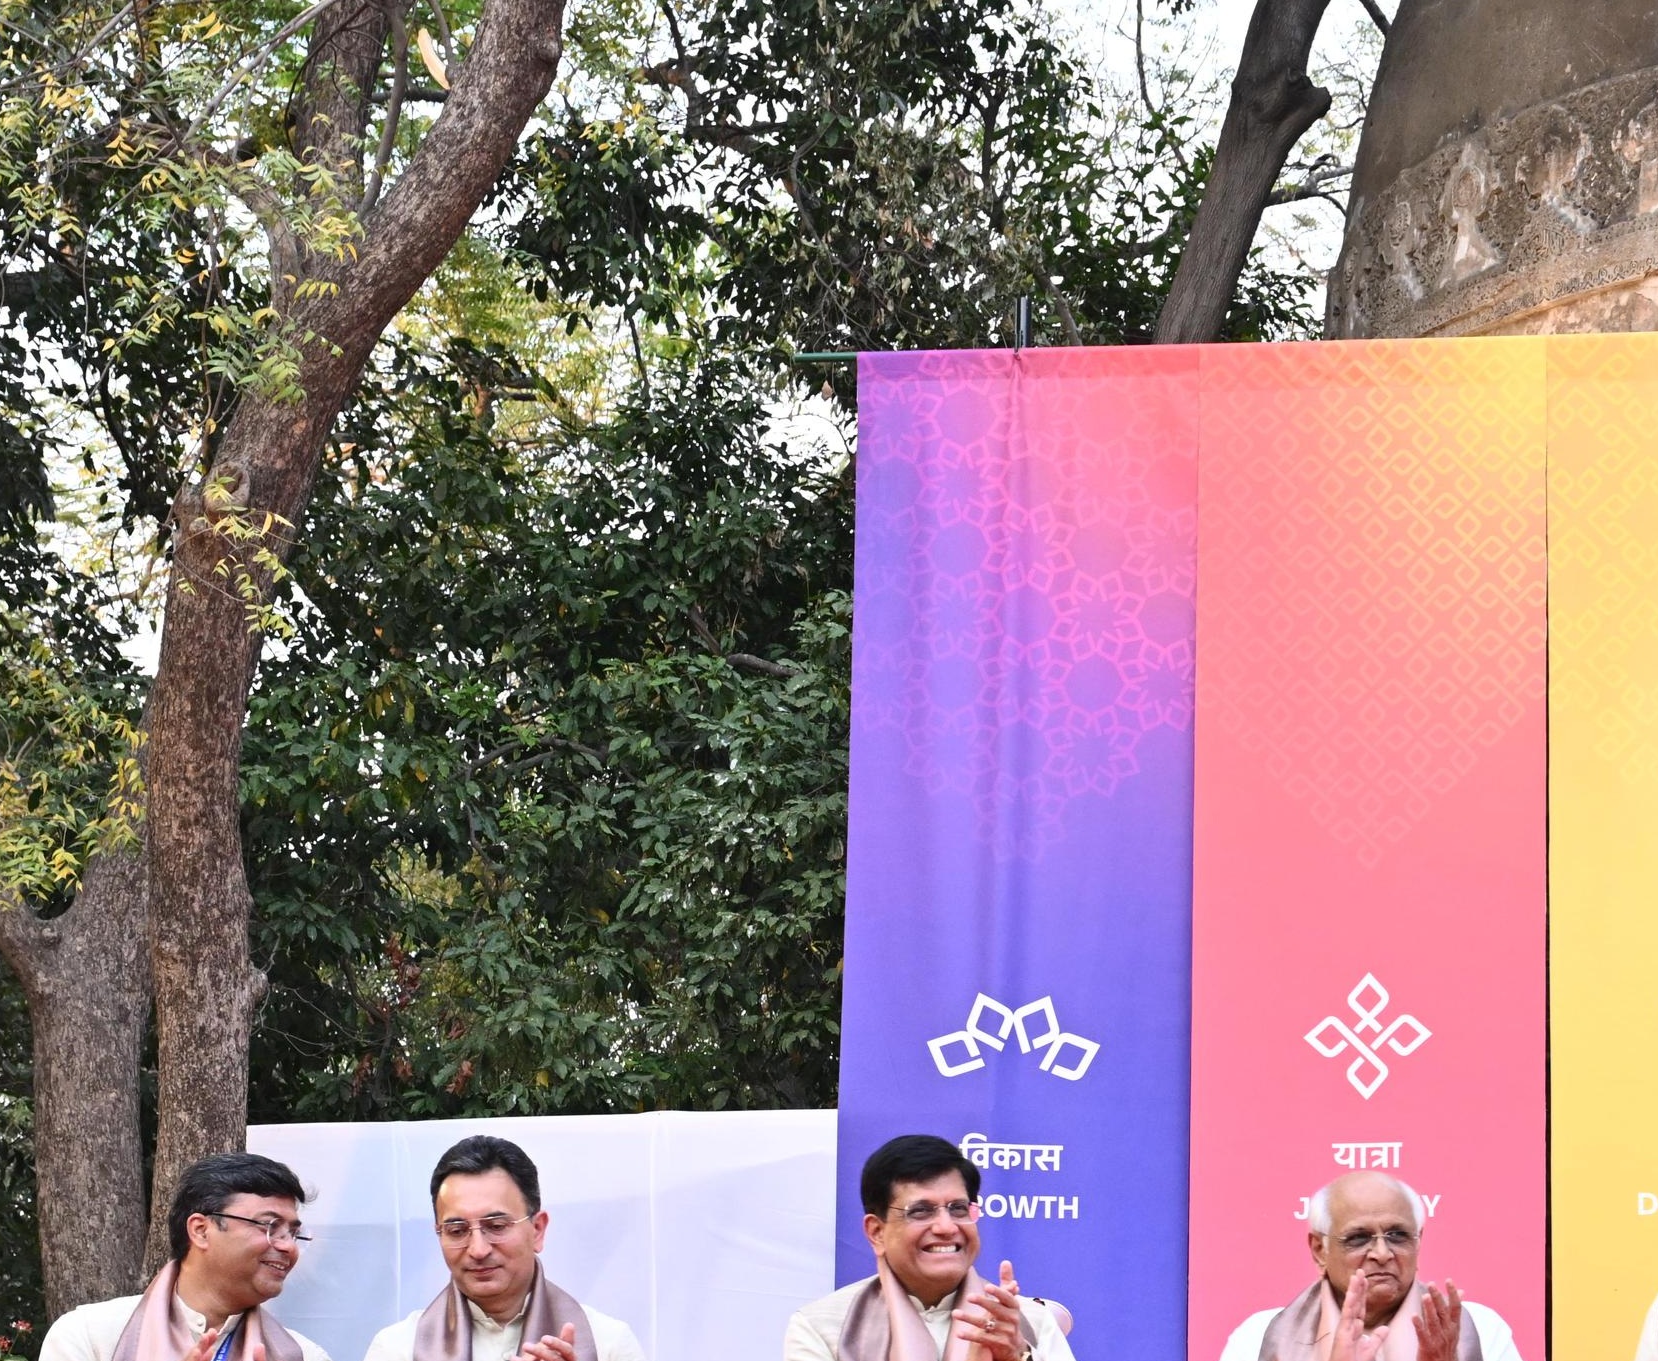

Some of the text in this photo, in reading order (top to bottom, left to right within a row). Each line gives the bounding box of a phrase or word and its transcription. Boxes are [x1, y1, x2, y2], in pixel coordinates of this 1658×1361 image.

[959, 1133, 1064, 1171] विकास
[1332, 1141, 1403, 1169] यात्रा
[977, 1194, 1079, 1219] OWTH
